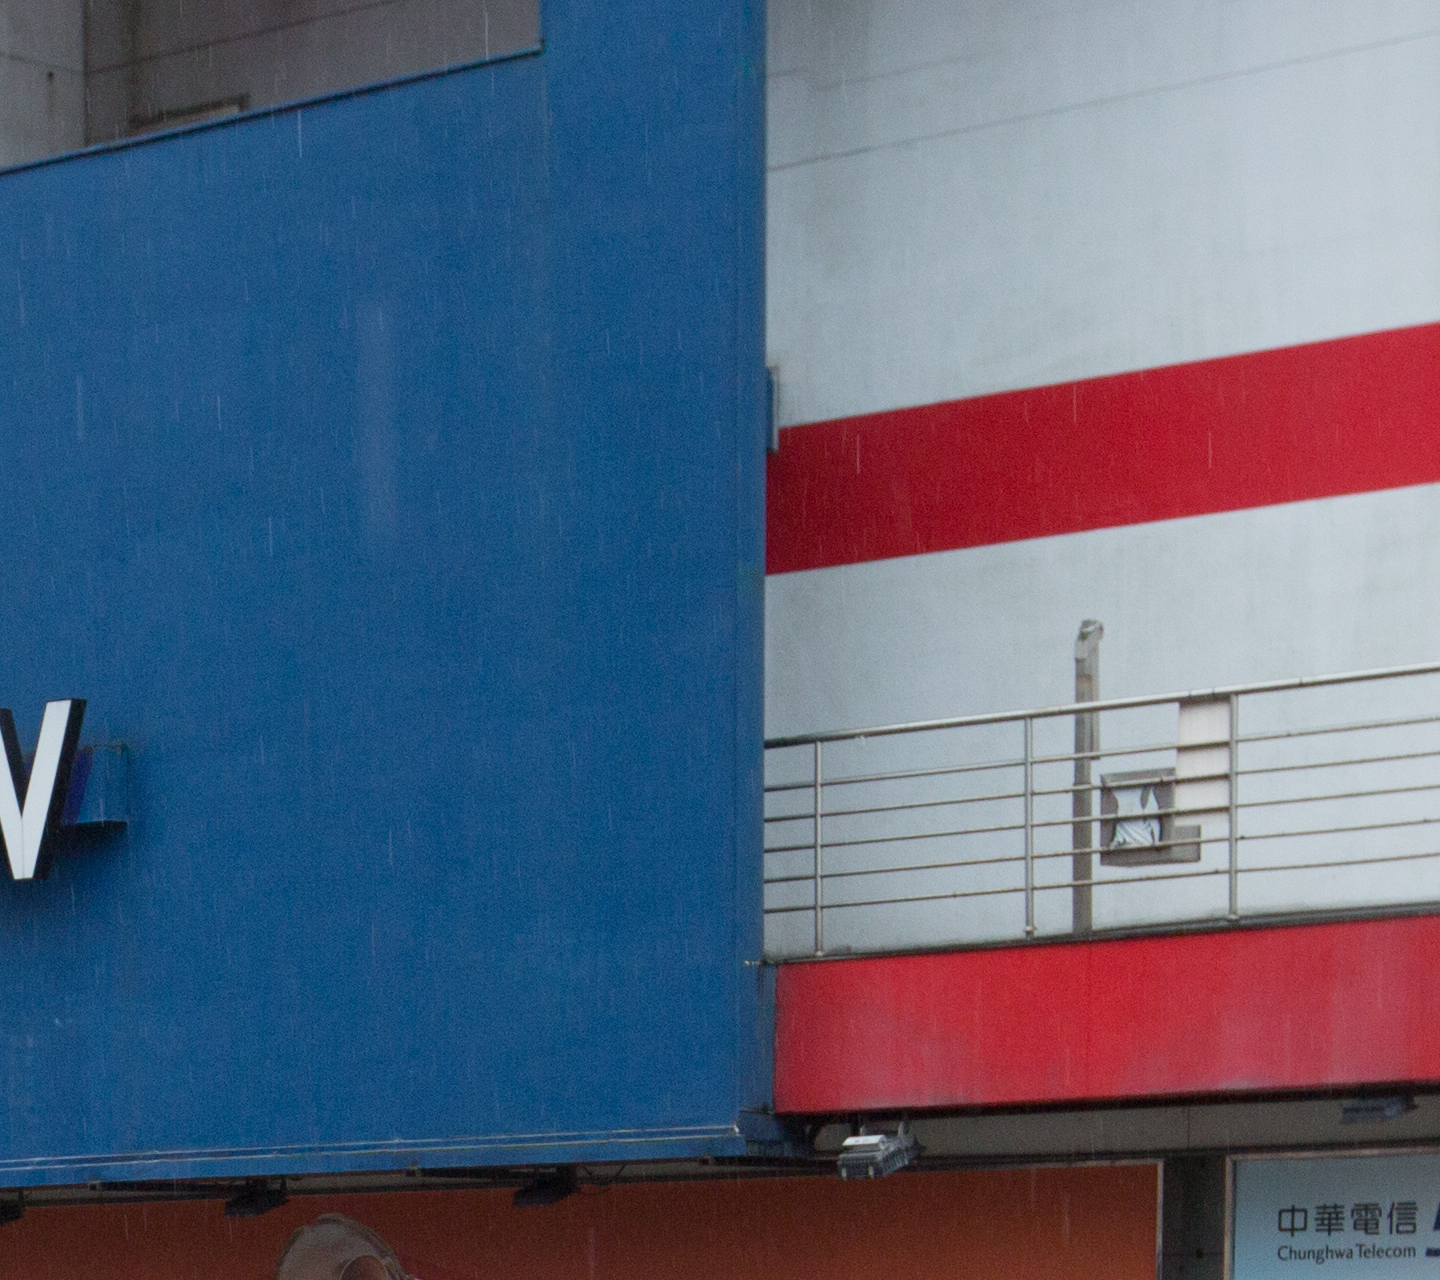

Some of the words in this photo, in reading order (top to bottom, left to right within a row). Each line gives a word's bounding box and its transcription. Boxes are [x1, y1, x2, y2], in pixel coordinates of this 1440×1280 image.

[1277, 1200, 1418, 1237] 中華電信
[1277, 1244, 1353, 1264] Chunghwa
[1355, 1243, 1417, 1260] Telecom
